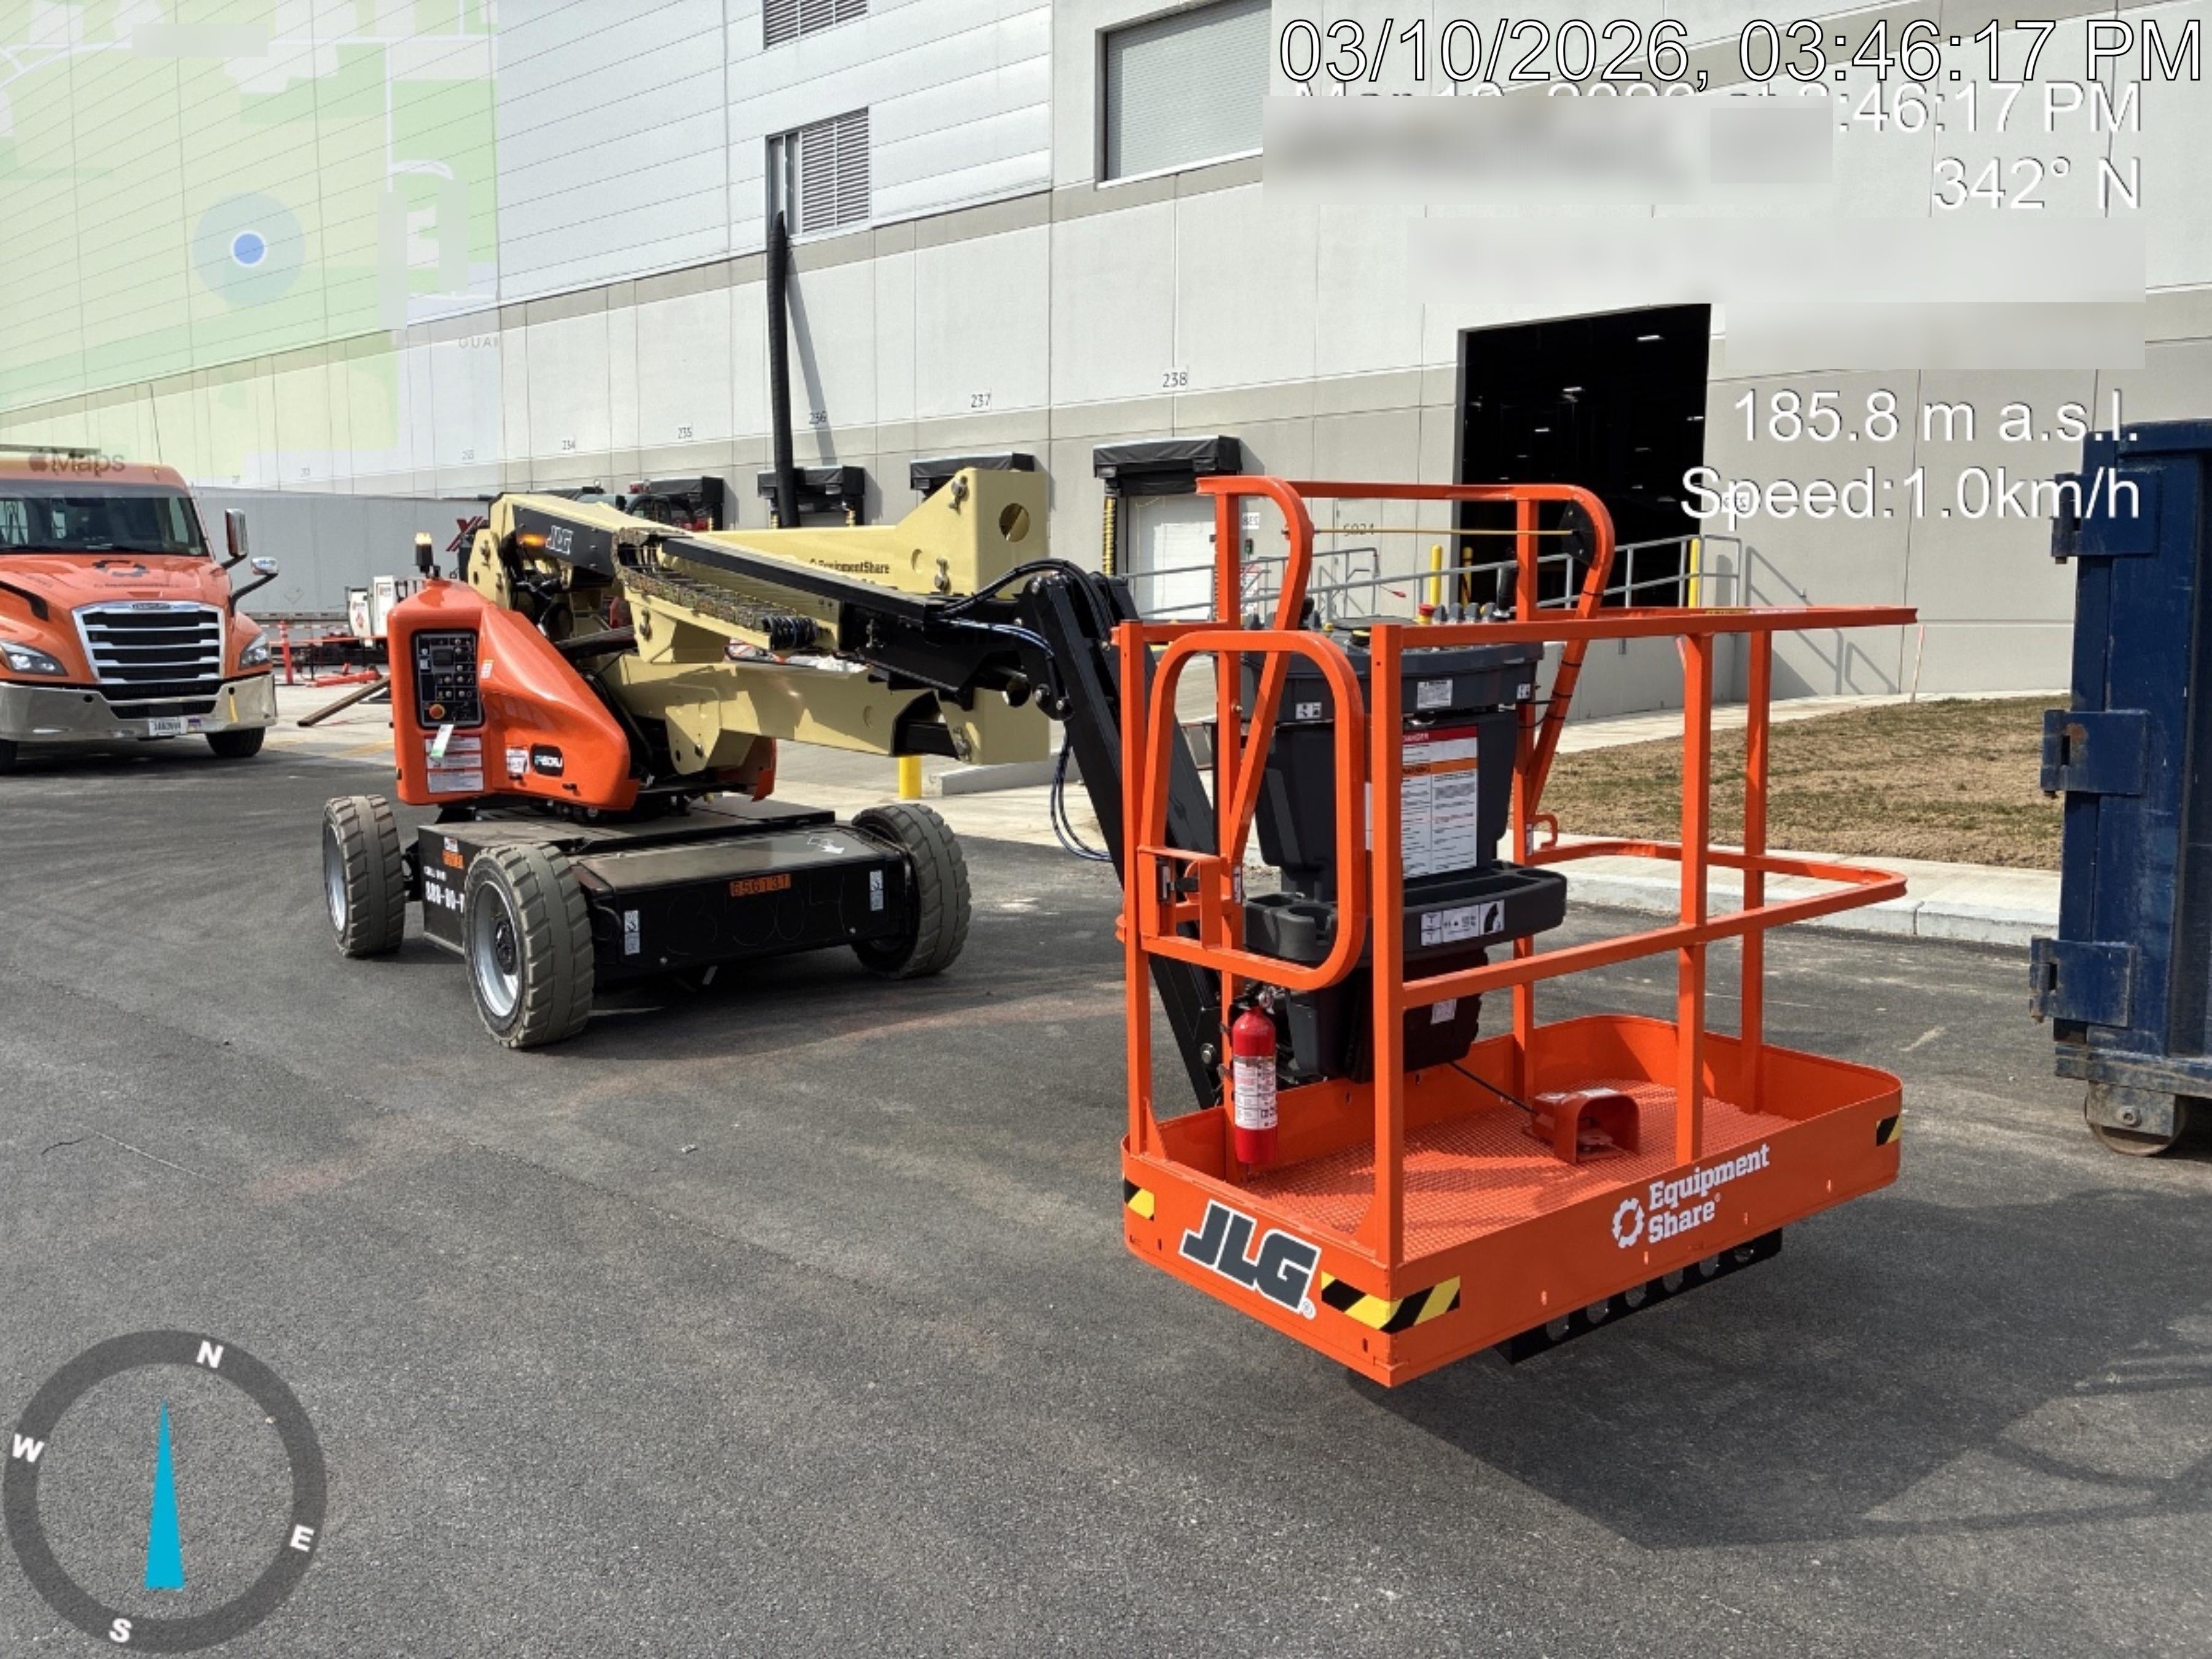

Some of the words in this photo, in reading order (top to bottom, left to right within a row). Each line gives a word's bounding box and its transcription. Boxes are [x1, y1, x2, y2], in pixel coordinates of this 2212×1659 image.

[971, 393, 991, 409] 237
[1162, 372, 1188, 388] 238
[1649, 1142, 1770, 1211] Equipment
[1649, 1201, 1716, 1244] Share
[1178, 1199, 1322, 1314] JLG
